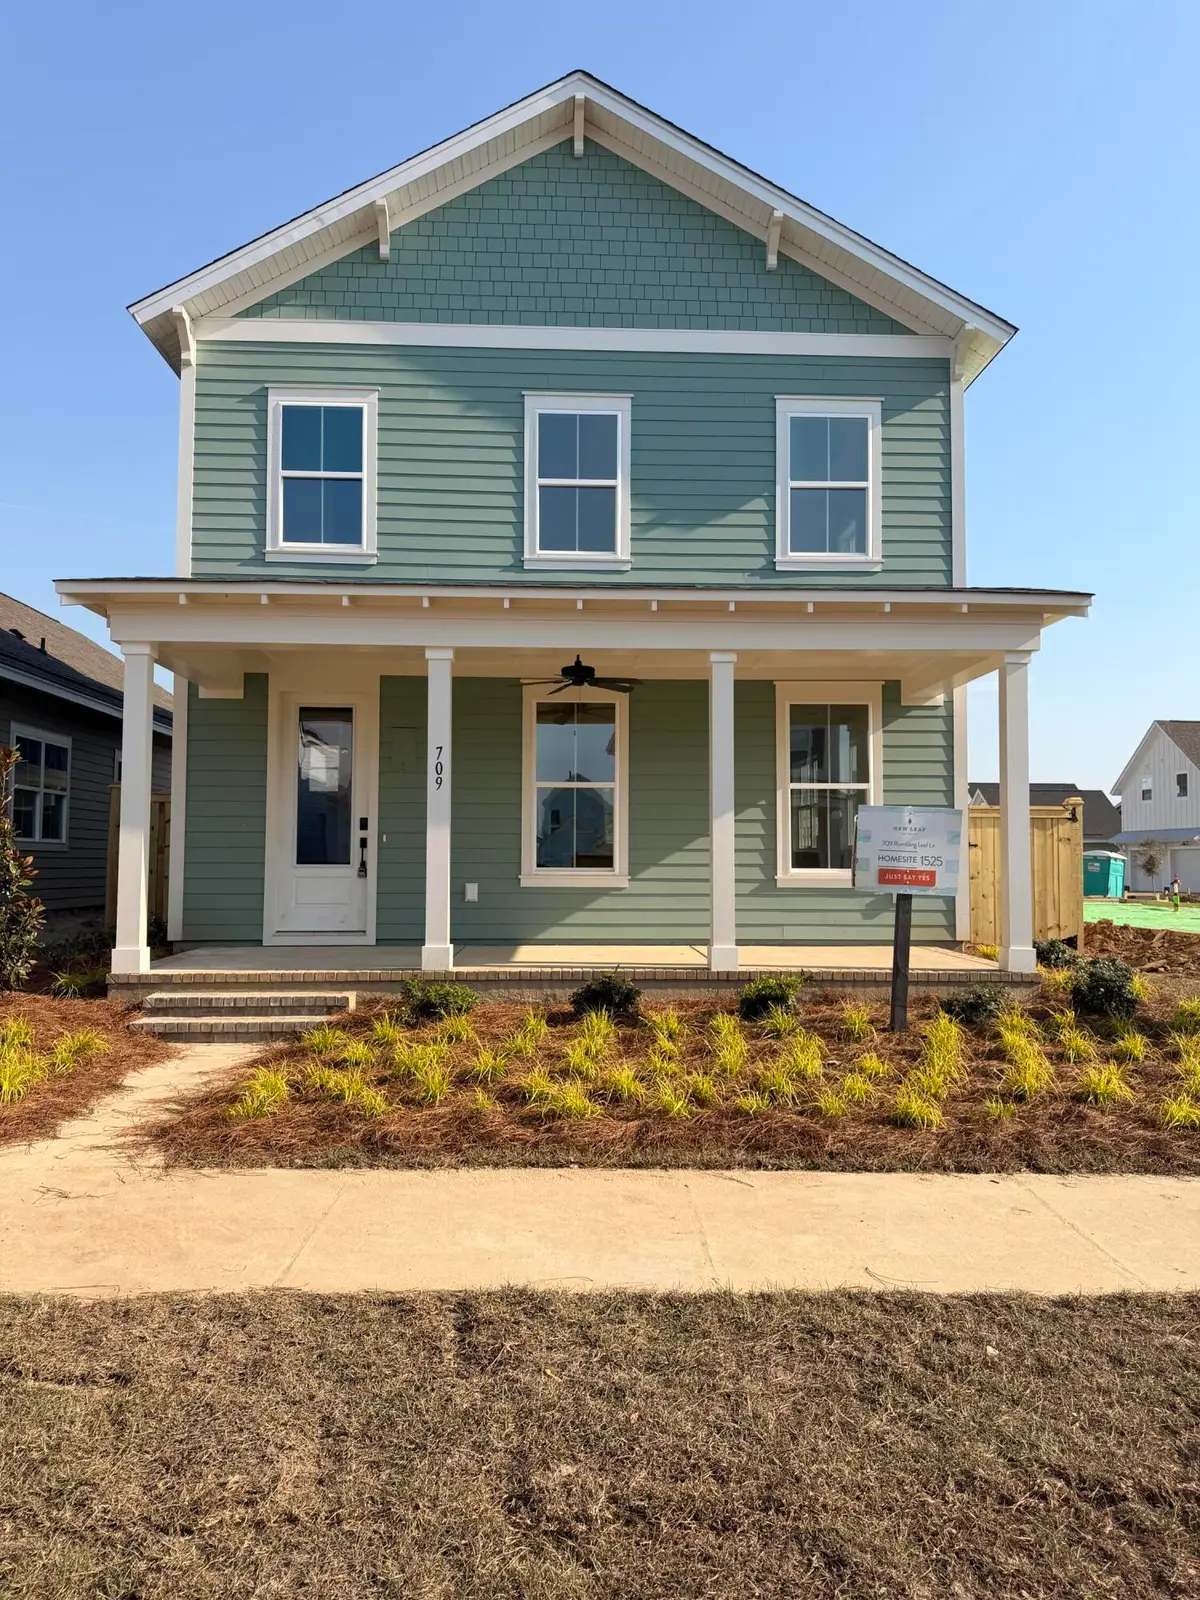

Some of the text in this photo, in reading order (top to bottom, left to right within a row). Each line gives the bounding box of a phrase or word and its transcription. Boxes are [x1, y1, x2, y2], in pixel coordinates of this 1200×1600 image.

[435, 746, 443, 790] 709
[878, 854, 943, 867] HOMESITE 1525
[903, 873, 915, 881] SAY
